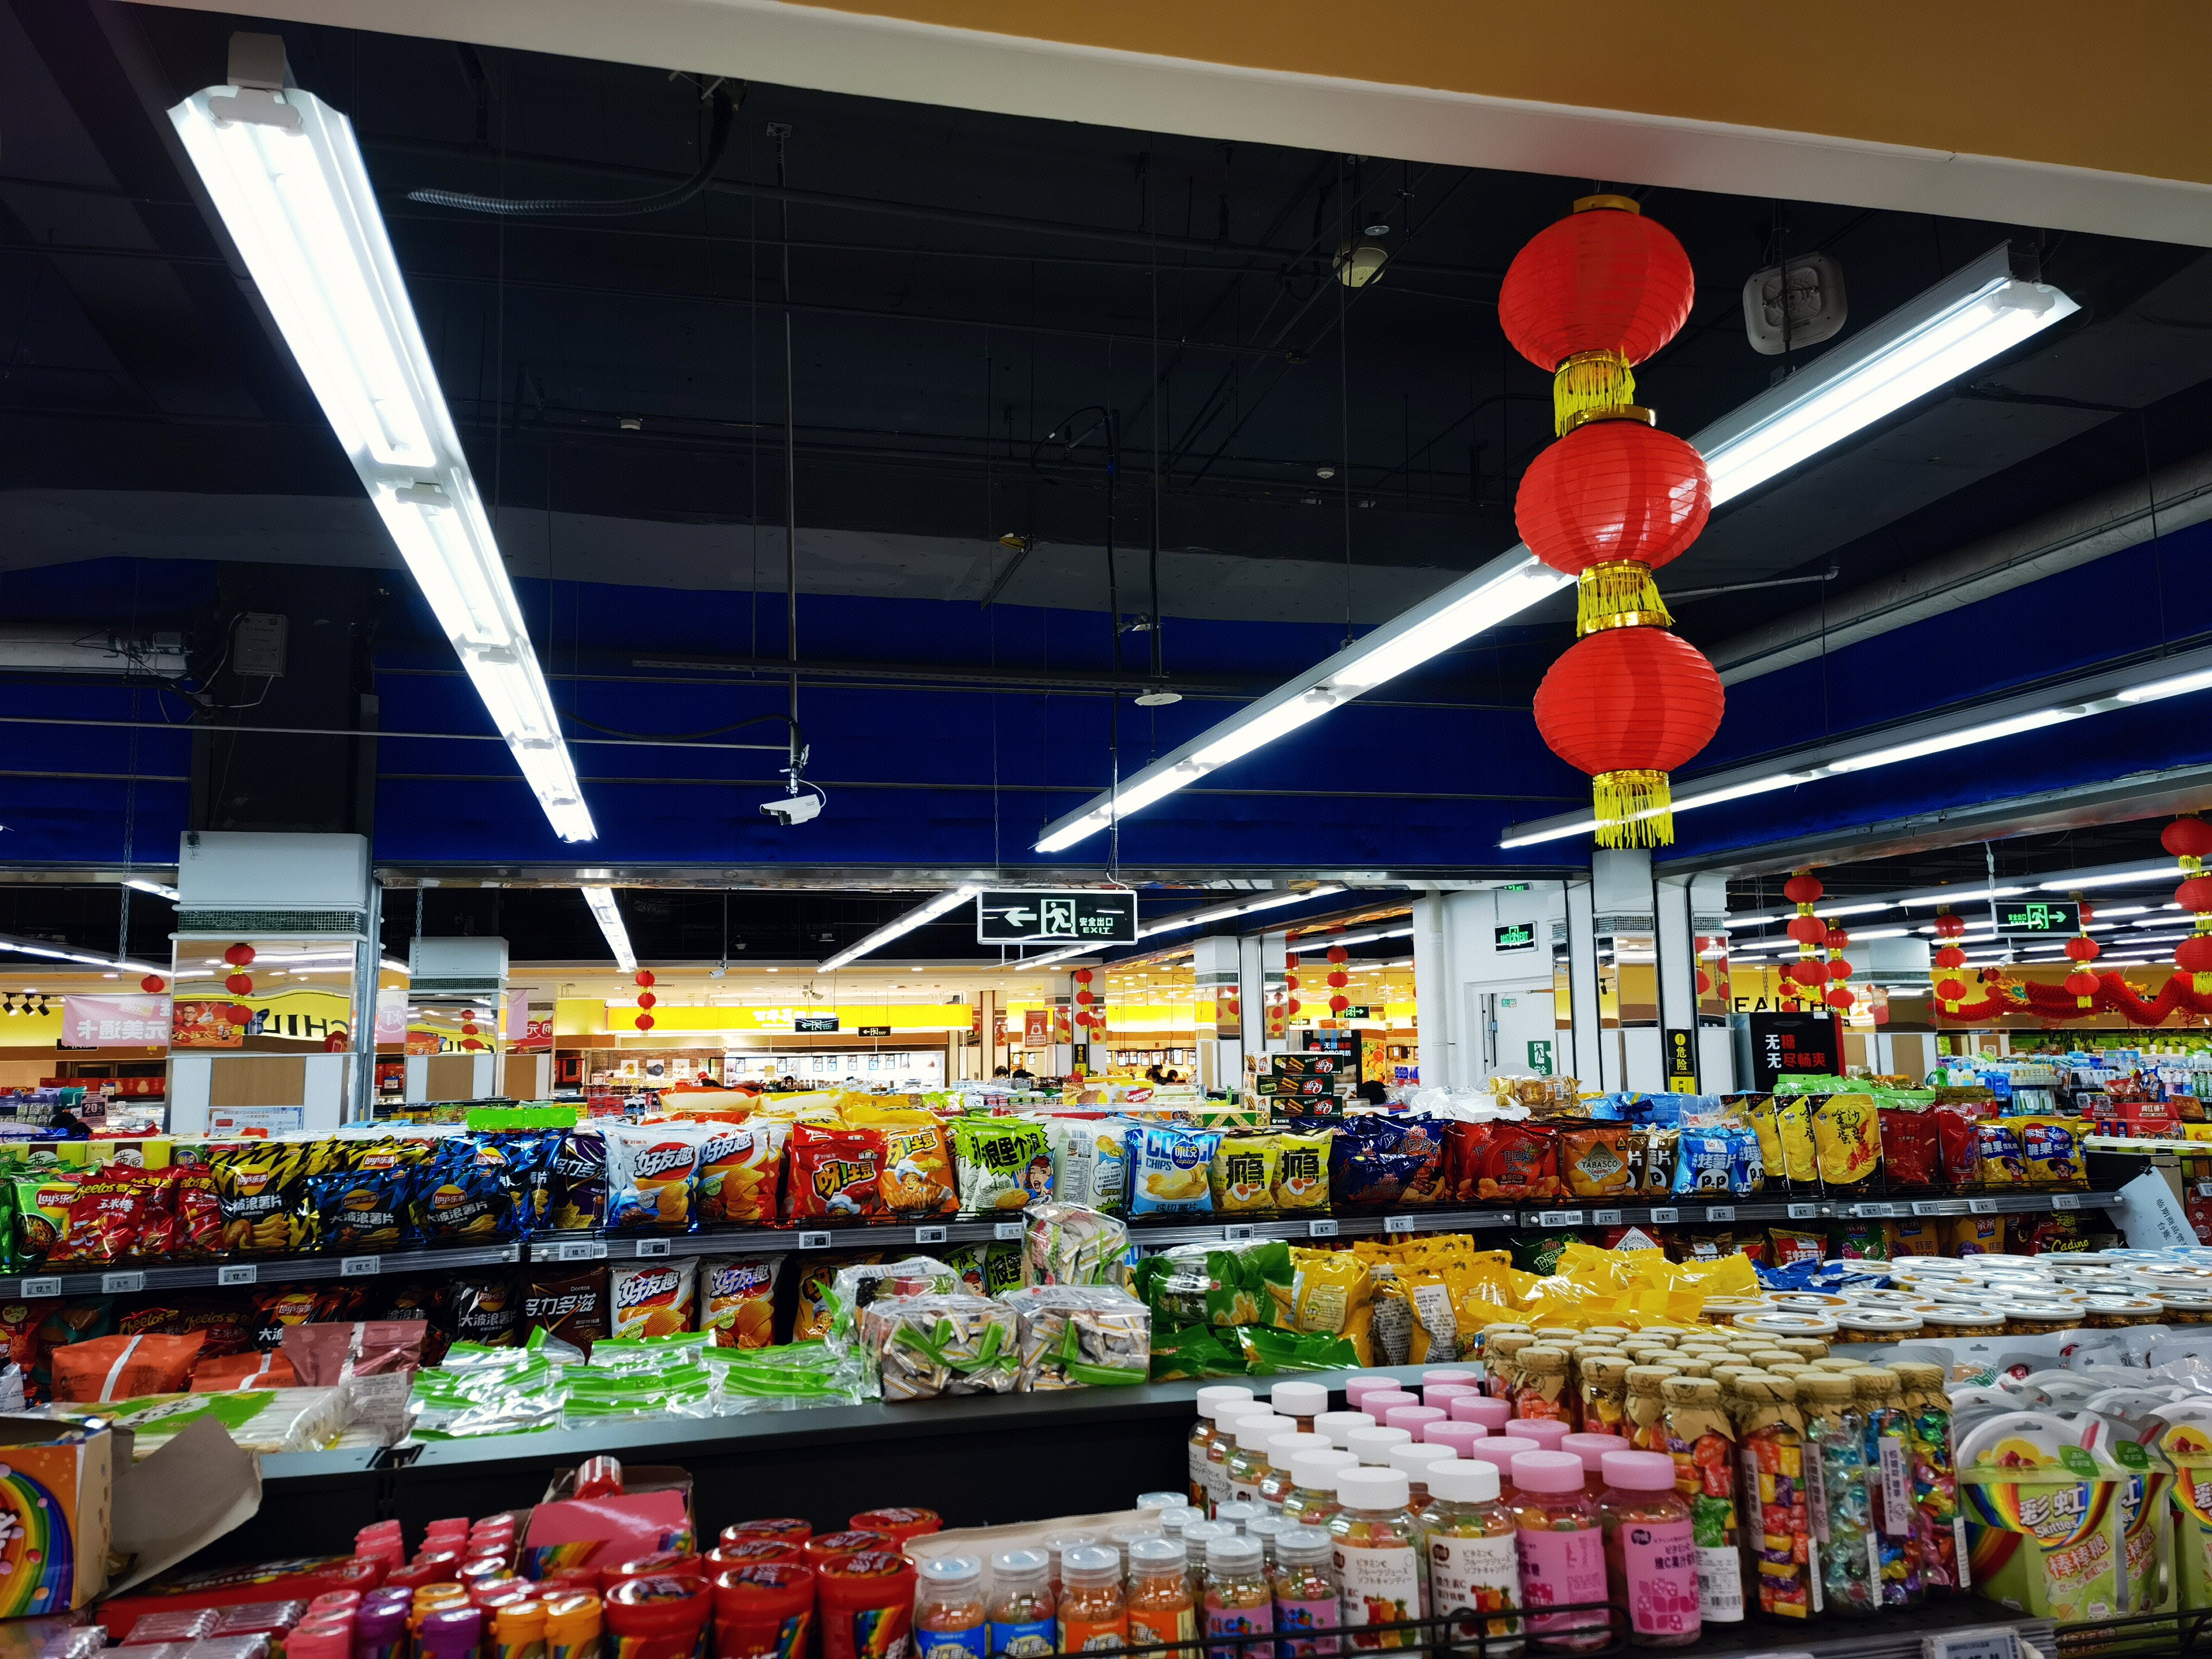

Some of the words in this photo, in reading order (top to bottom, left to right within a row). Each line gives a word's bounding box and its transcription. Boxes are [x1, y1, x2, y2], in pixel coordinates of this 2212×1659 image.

[1079, 917, 1114, 927] 安全出口
[1519, 931, 1528, 942] EXIT
[1765, 1034, 1796, 1050] 无糖
[1676, 1046, 1687, 1071] 危险
[1766, 1053, 1826, 1069] 无尽畅爽
[700, 1132, 753, 1164] 好友趣
[1174, 1145, 1198, 1158] 可比克
[1980, 1141, 2004, 1155] 脆果
[2027, 1142, 2053, 1156] 脆果
[634, 1146, 694, 1177] 好友趣
[1145, 1157, 1172, 1171] CHIPS
[1581, 1159, 1618, 1169] TABASCO
[1697, 1152, 1737, 1170] 烤薯片
[328, 1211, 395, 1226] 大波浪薯片
[427, 1200, 488, 1223] 大波浪薯片
[617, 1270, 681, 1309] 好友趣
[710, 1263, 771, 1298] 好友趣
[525, 1292, 597, 1317] 多力多滋
[2019, 1485, 2087, 1526] 彩虹
[2034, 1519, 2079, 1539] Skittles
[2046, 1533, 2111, 1578] 棒棒糖
